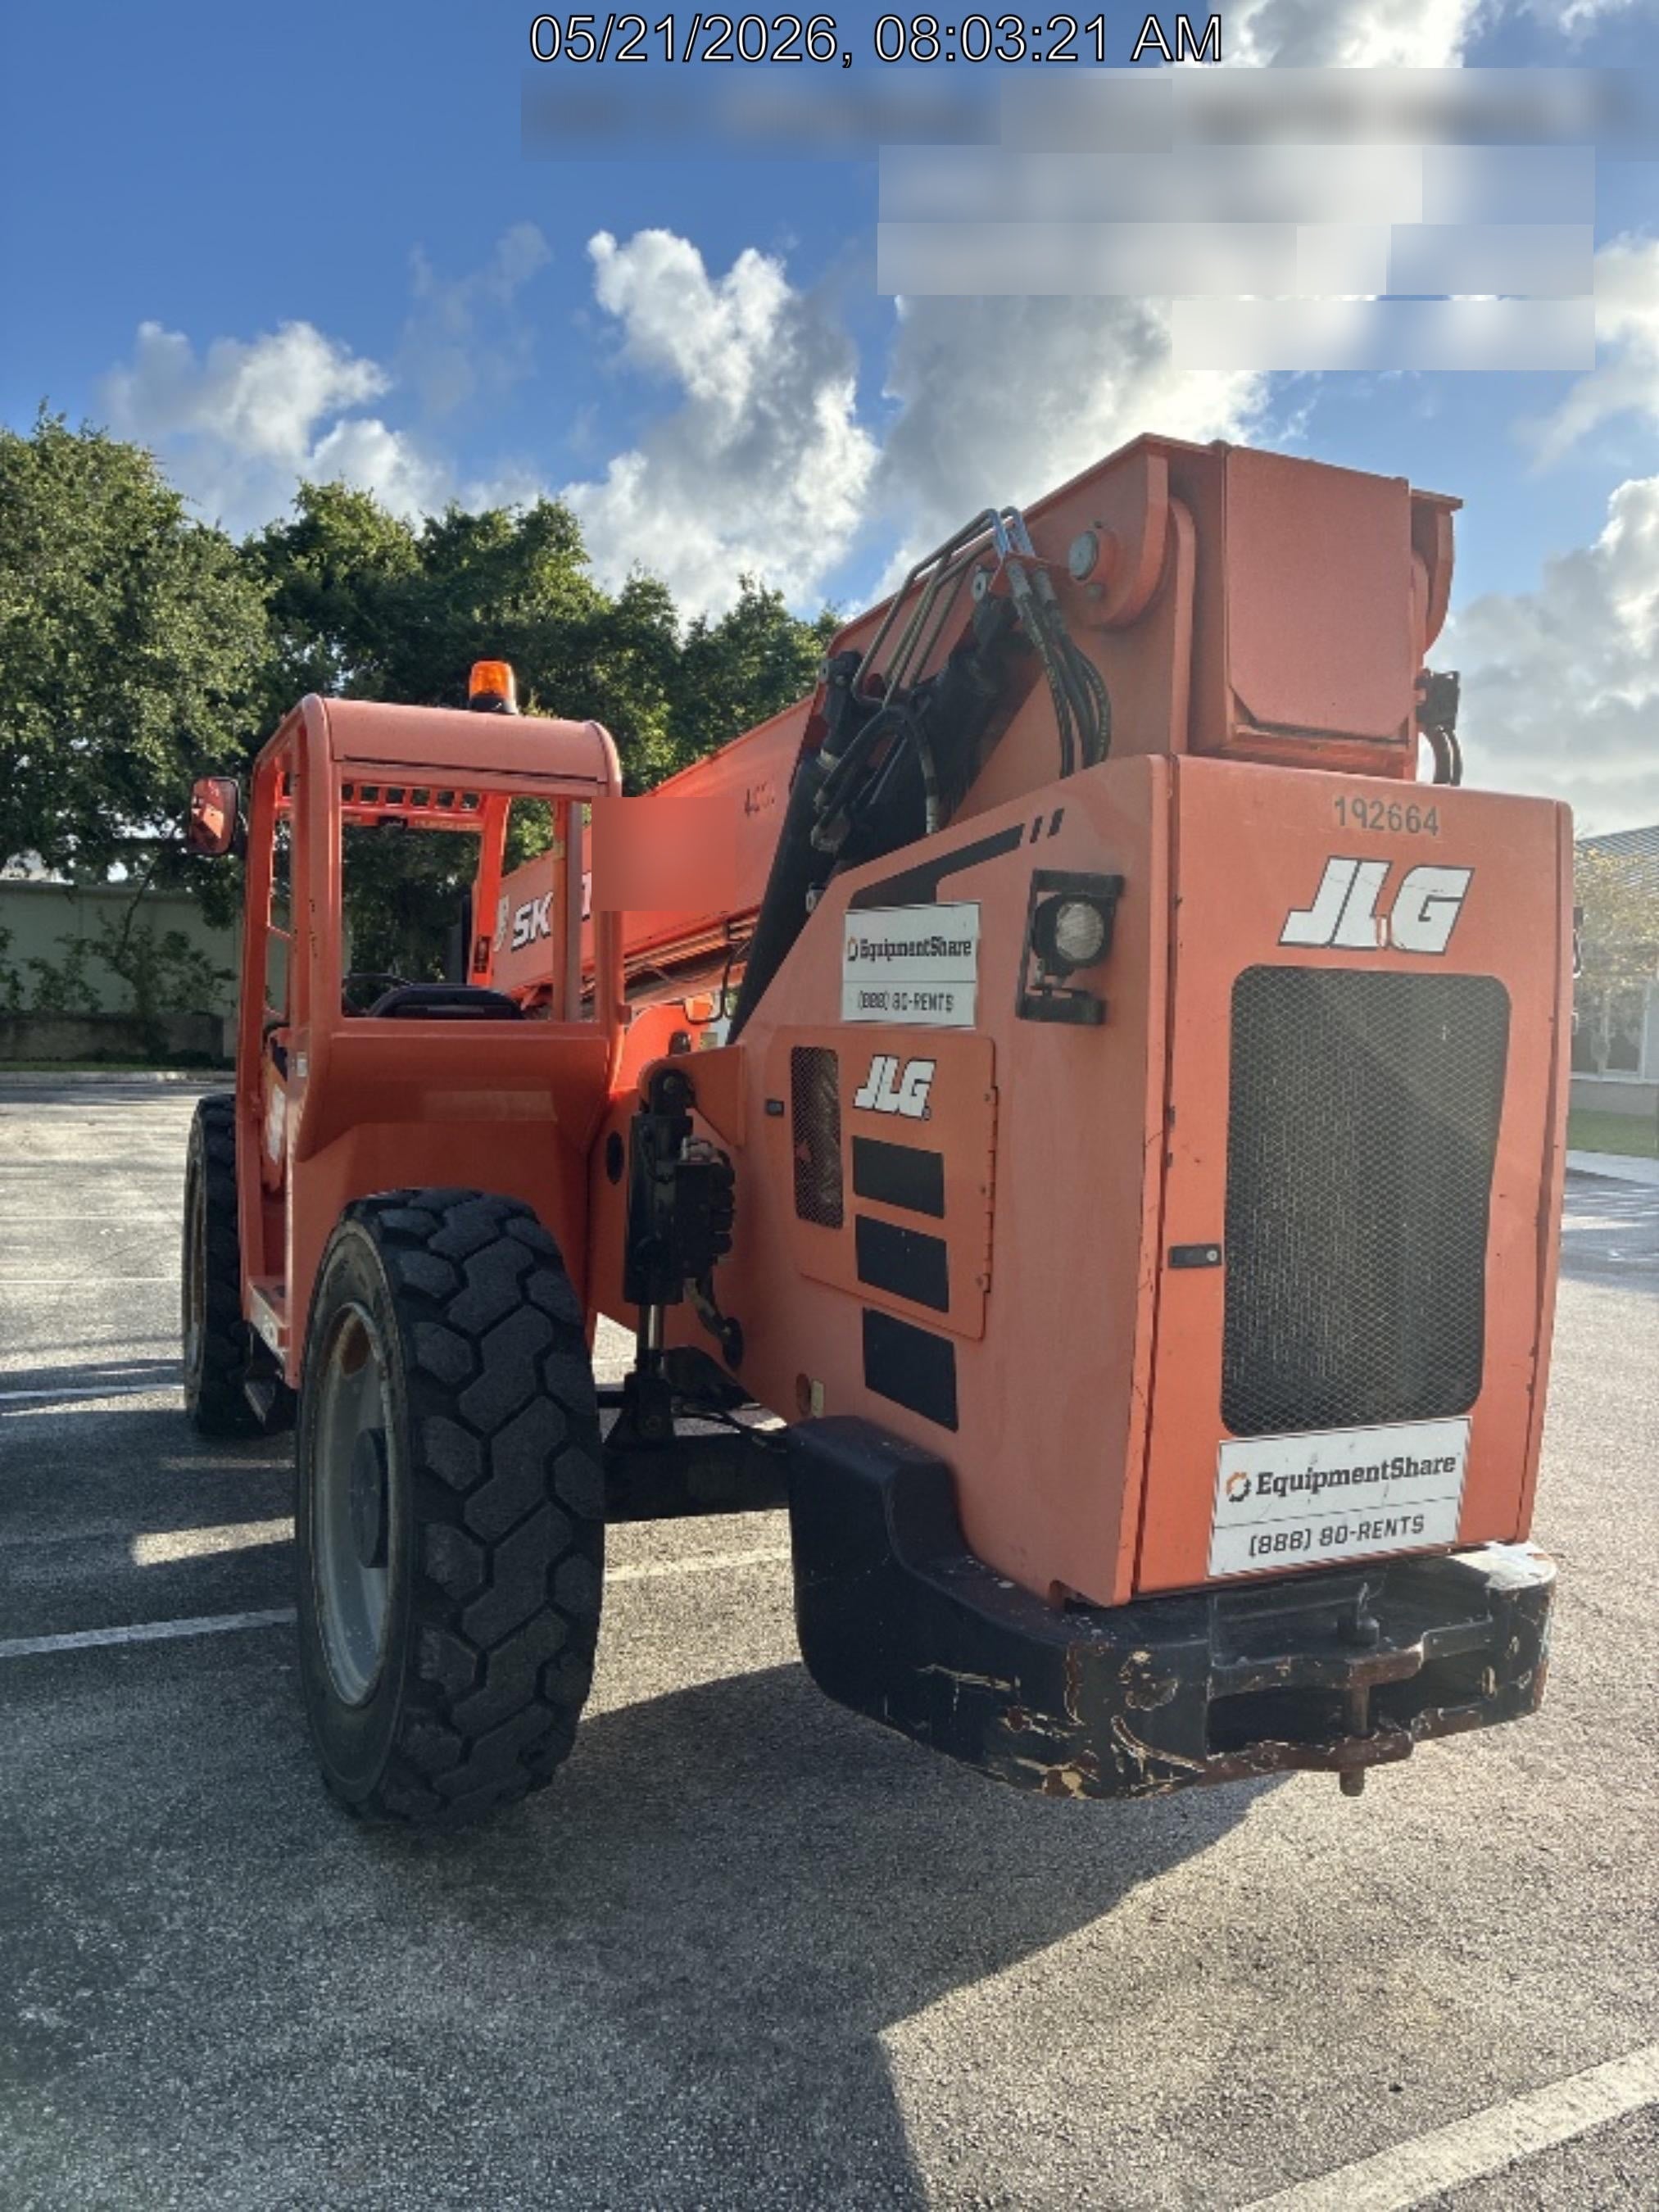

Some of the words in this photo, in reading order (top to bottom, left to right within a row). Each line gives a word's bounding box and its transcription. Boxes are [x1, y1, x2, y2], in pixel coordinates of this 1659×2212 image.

[1335, 796, 1439, 836] 192664
[1278, 855, 1475, 955] JLG
[860, 936, 972, 962] EquipmentShare
[853, 1054, 936, 1119] JLG
[1256, 1456, 1457, 1498] EquipmentShare
[1318, 1515, 1426, 1547] 80-RENTS
